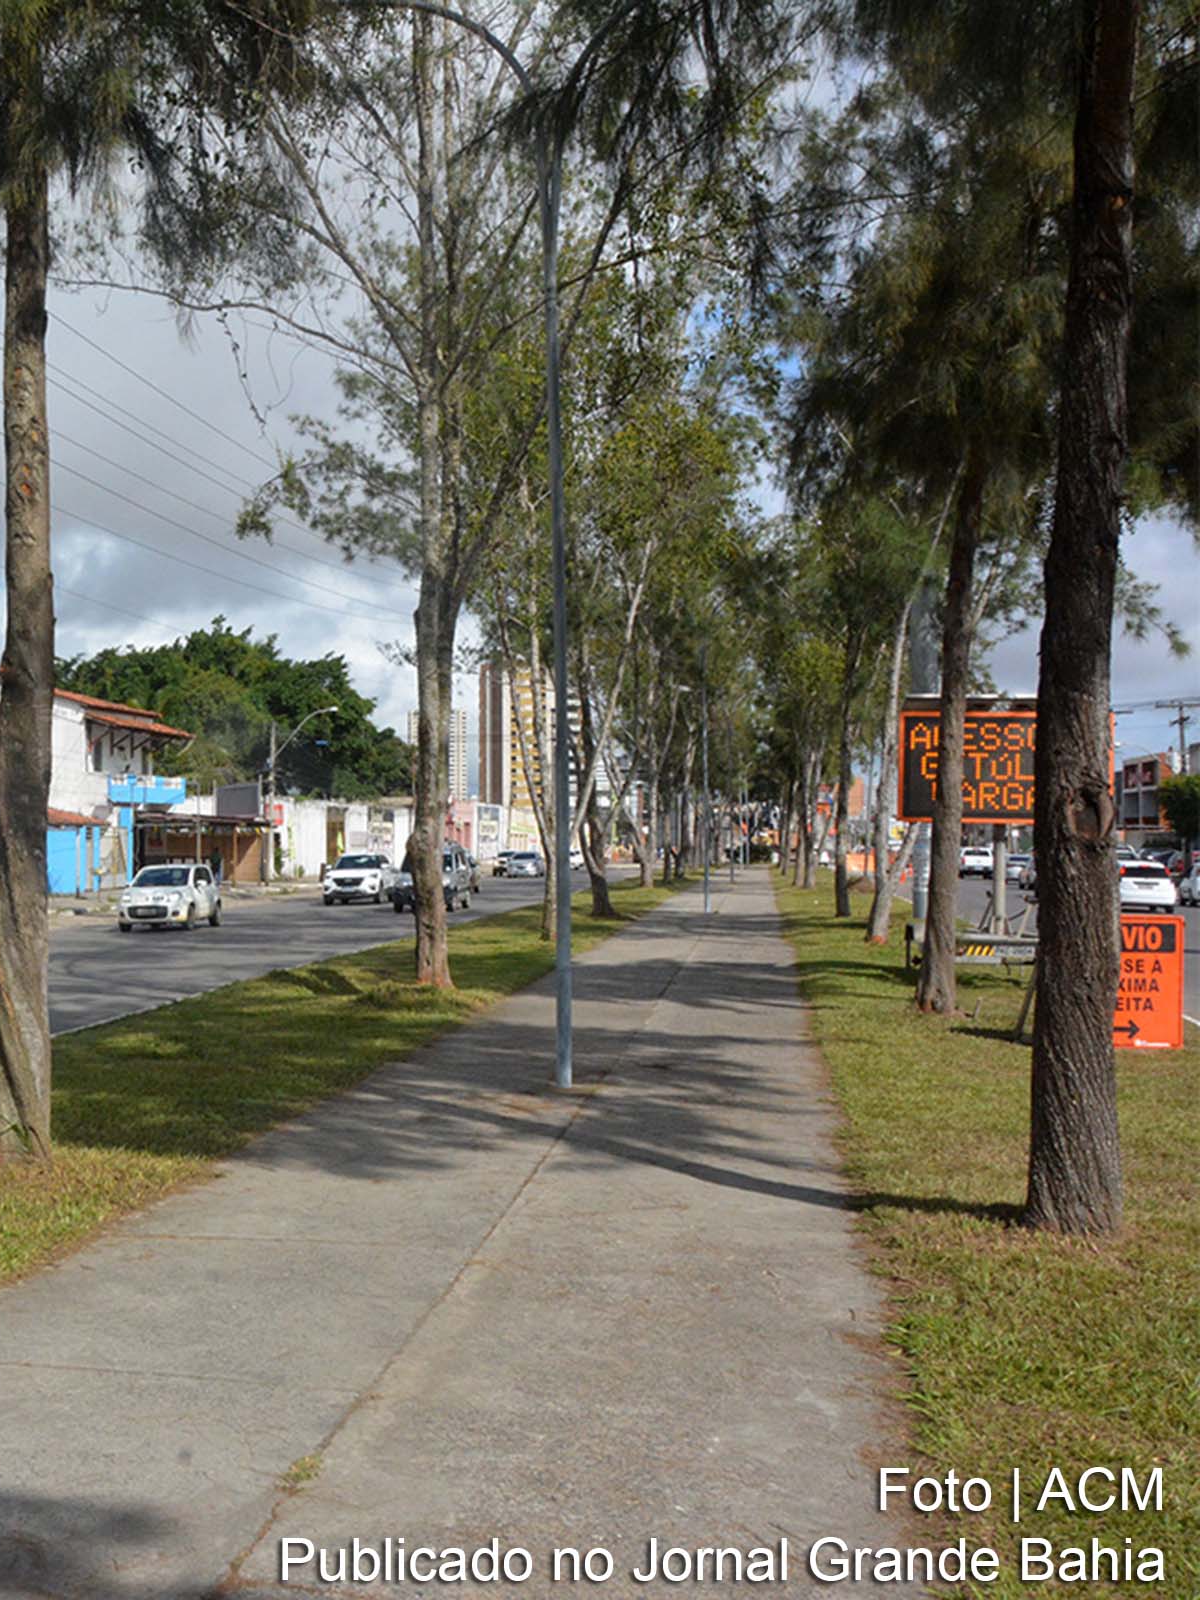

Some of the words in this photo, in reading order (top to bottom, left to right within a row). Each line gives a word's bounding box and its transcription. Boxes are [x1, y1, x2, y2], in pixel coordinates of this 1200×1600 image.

[910, 722, 1037, 750] AESS
[921, 752, 1035, 780] GTÚL
[1122, 959, 1144, 974] SE
